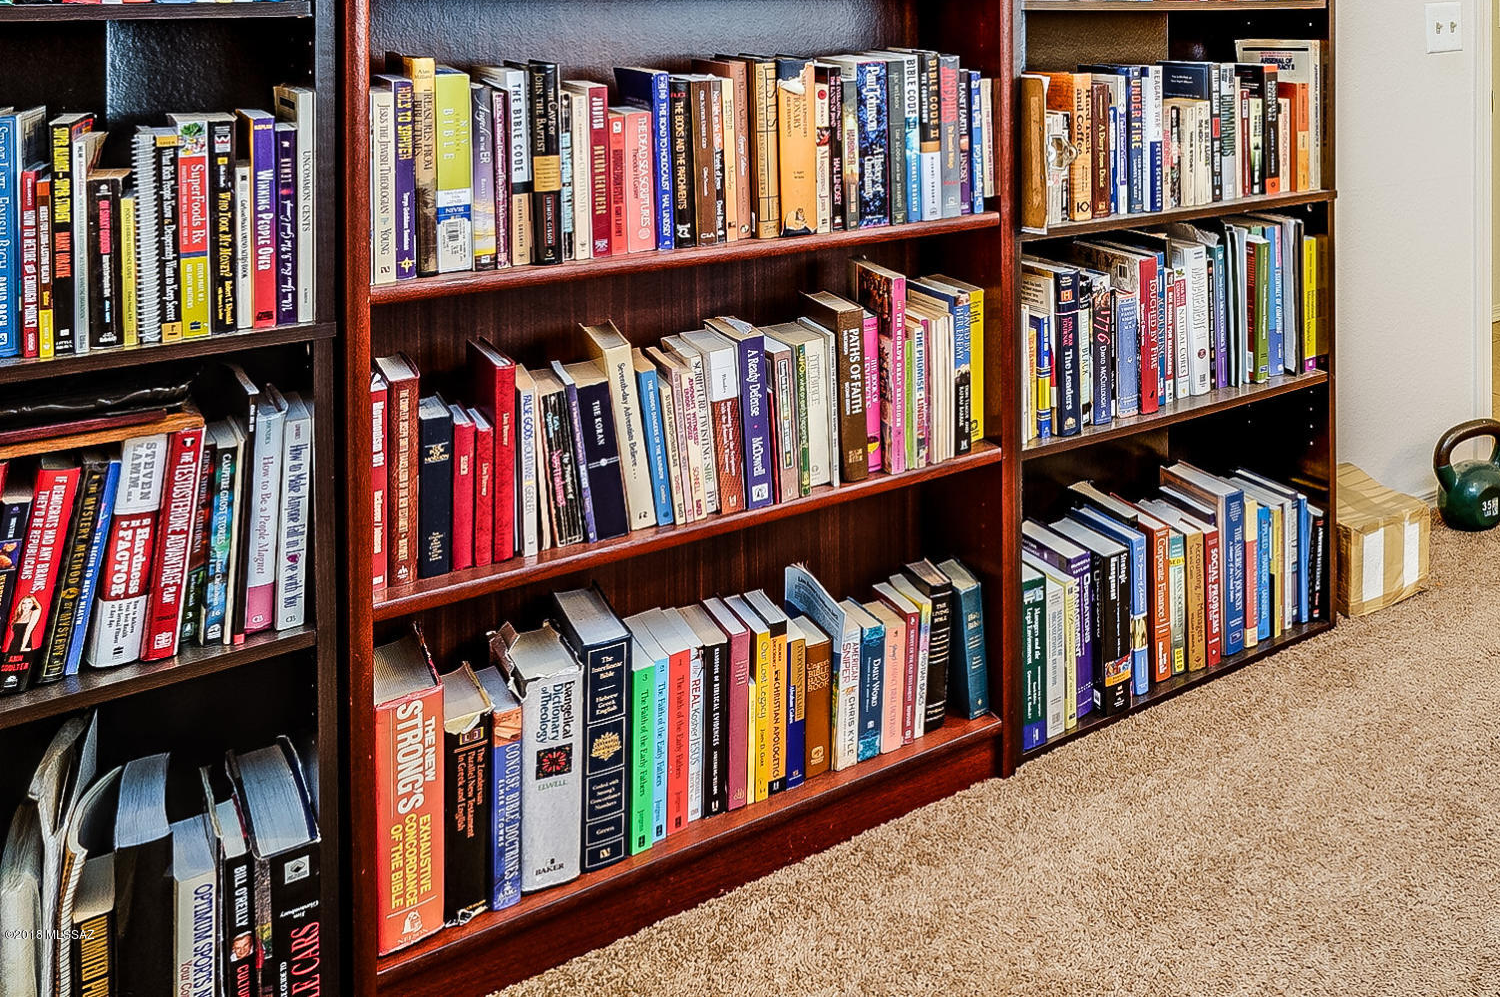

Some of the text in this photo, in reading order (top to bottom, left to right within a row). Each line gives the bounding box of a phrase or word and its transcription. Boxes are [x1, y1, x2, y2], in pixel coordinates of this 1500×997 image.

[534, 72, 545, 95] JOHN
[377, 104, 391, 123] JESUS
[513, 108, 523, 141] BIBLE
[1131, 79, 1142, 149] UNDER FIRE
[377, 140, 391, 166] JEWISH
[535, 118, 546, 152] BAPTIST
[659, 138, 667, 147] TO
[514, 145, 524, 172] CODE
[188, 164, 205, 243] SuperFoods Rx
[301, 151, 312, 232] UNCOMMON CENTS
[380, 167, 392, 214] THEOLOGIAN
[256, 169, 274, 271] WINNING PEOPLE OVER
[661, 194, 671, 236] HAL LINDSEY
[381, 230, 392, 255] YOUNG
[1094, 310, 1110, 343] 1776
[745, 358, 759, 382] Ready
[848, 328, 862, 414] PATHS OF FAITH
[916, 350, 924, 393] PROMISE
[1065, 371, 1074, 410] Leaders
[617, 363, 638, 467] Seventh-day Adventists Believe
[749, 384, 761, 416] Defense
[917, 398, 925, 437] LINDSEY
[594, 418, 605, 445] KORAN
[139, 443, 158, 500] STEVEN
[260, 456, 273, 478] How
[372, 453, 384, 467] 101
[752, 437, 766, 477] McDowell
[45, 485, 65, 527] DEMOCRATS
[168, 462, 195, 531] TESTOSTERONE
[260, 494, 271, 505] Be
[21, 491, 51, 580] THEY'D BE REPUBLICANS
[42, 529, 57, 545] HAD
[77, 497, 96, 539] MYSTERY
[254, 515, 270, 539] People
[39, 547, 53, 561] ANY
[68, 545, 86, 583] METHOD
[110, 529, 132, 597] FACTOR
[128, 528, 151, 594] Hardness
[159, 534, 188, 587] ADVANTAGE
[253, 542, 270, 574] Magnet
[30, 563, 51, 594] BRAINS,
[1156, 539, 1167, 617] Corporate Finance
[1210, 549, 1219, 634] SOCIAL PROBLEMS
[52, 613, 71, 656] MYSTERY
[758, 641, 768, 719] Our Lost Legacy
[842, 643, 851, 683] SNIPER
[850, 642, 859, 681] AMERICAN
[1175, 650, 1183, 669] USED
[536, 694, 551, 743] Theology
[548, 683, 564, 741] Dictionary
[561, 682, 575, 739] Evangelical
[771, 682, 781, 778] CHRISTIAN APOLOGETICS
[847, 696, 856, 756] CHRIS KYLE
[396, 700, 425, 815] STRONG'S
[424, 743, 435, 782] NEW
[391, 824, 403, 841] OF
[504, 743, 521, 880] CONCISE BIBLE DOCTRINES
[405, 813, 417, 908] CONCORDANCE
[419, 814, 432, 894] EXHAUSTIVE
[233, 865, 248, 927] BILL O'REILLY
[391, 873, 403, 909] BIBLE
[193, 883, 214, 984] OPTIMUM SPORTS
